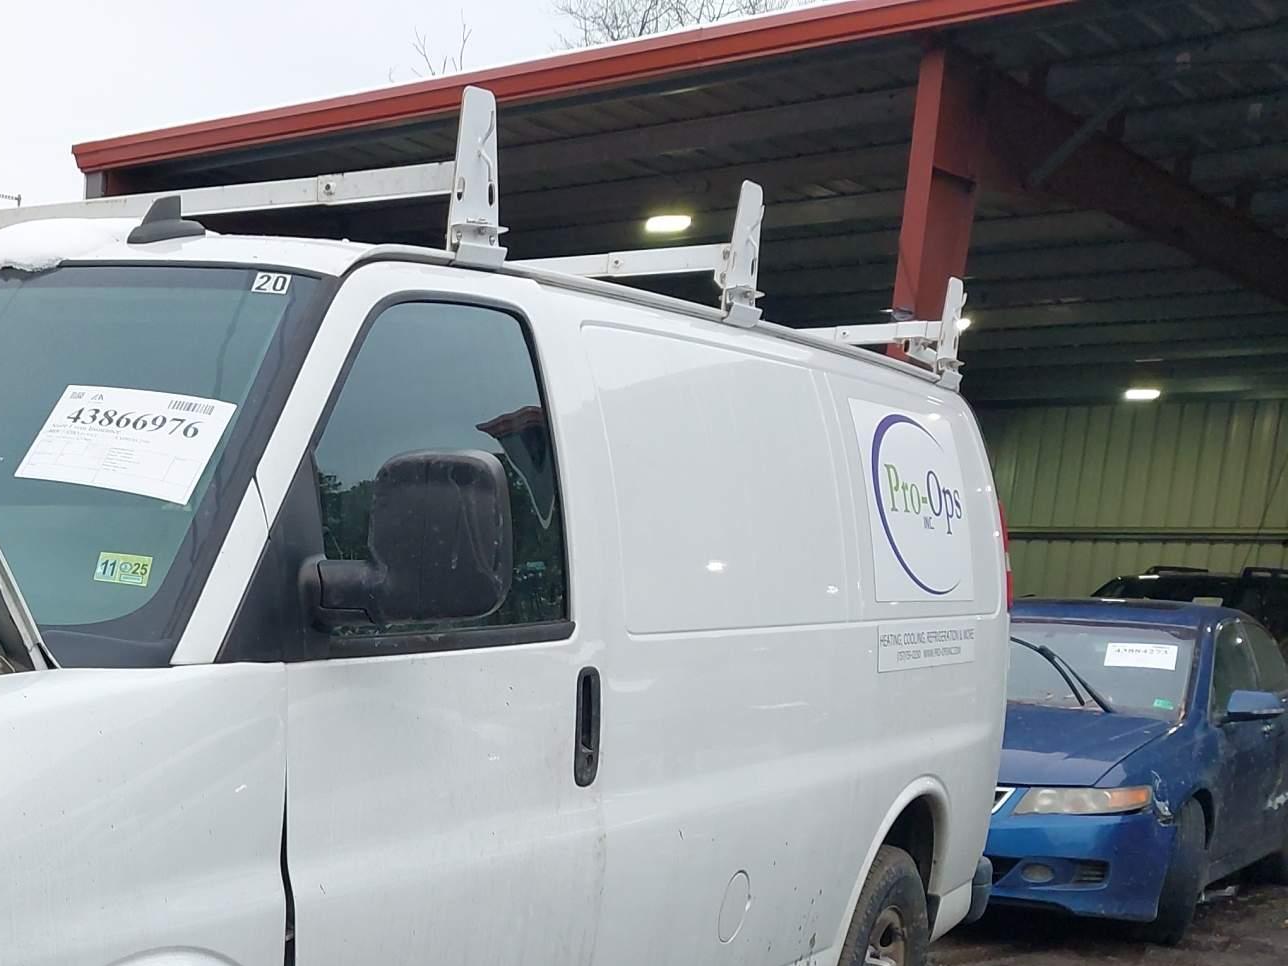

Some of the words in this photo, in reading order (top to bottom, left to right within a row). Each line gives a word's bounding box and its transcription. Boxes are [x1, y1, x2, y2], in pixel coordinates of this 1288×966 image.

[254, 274, 287, 292] 20
[67, 407, 203, 438] 43866976
[884, 463, 962, 535] Pro-Ops
[100, 559, 117, 577] 11
[132, 562, 149, 576] 25
